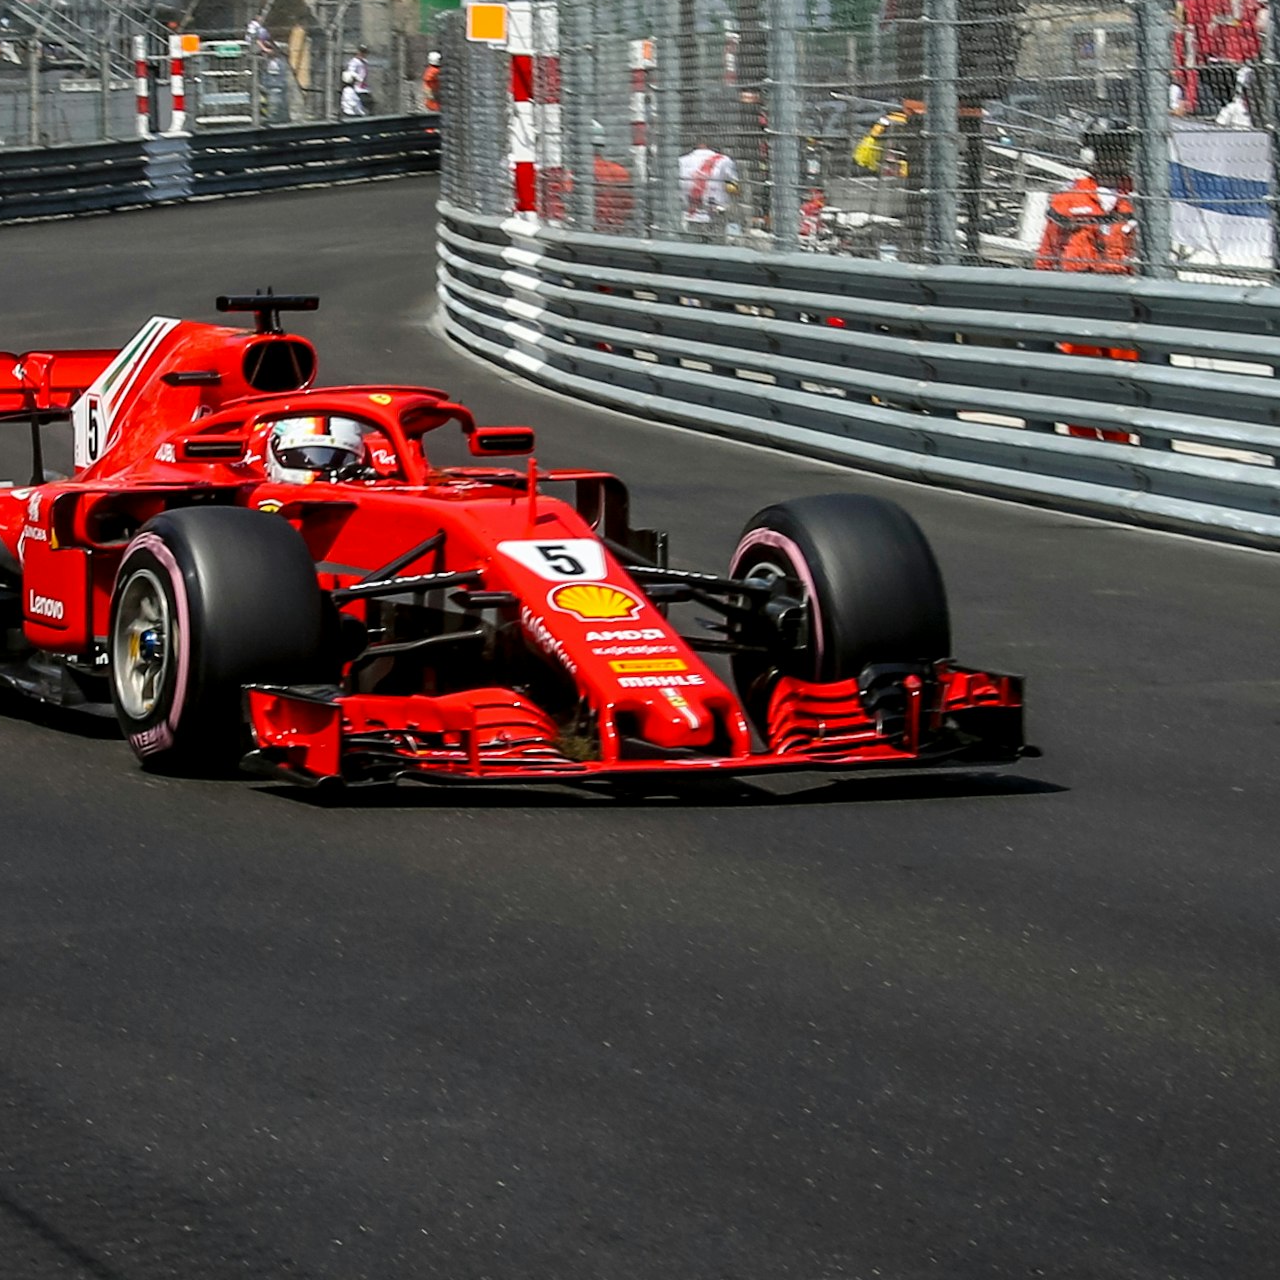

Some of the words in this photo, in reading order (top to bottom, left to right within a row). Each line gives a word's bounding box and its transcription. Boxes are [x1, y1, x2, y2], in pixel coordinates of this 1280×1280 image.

[88, 399, 98, 461] 5
[535, 544, 585, 575] 5
[29, 589, 64, 619] Lenovo
[586, 629, 643, 642] AMD
[617, 674, 706, 688] MAHLE
